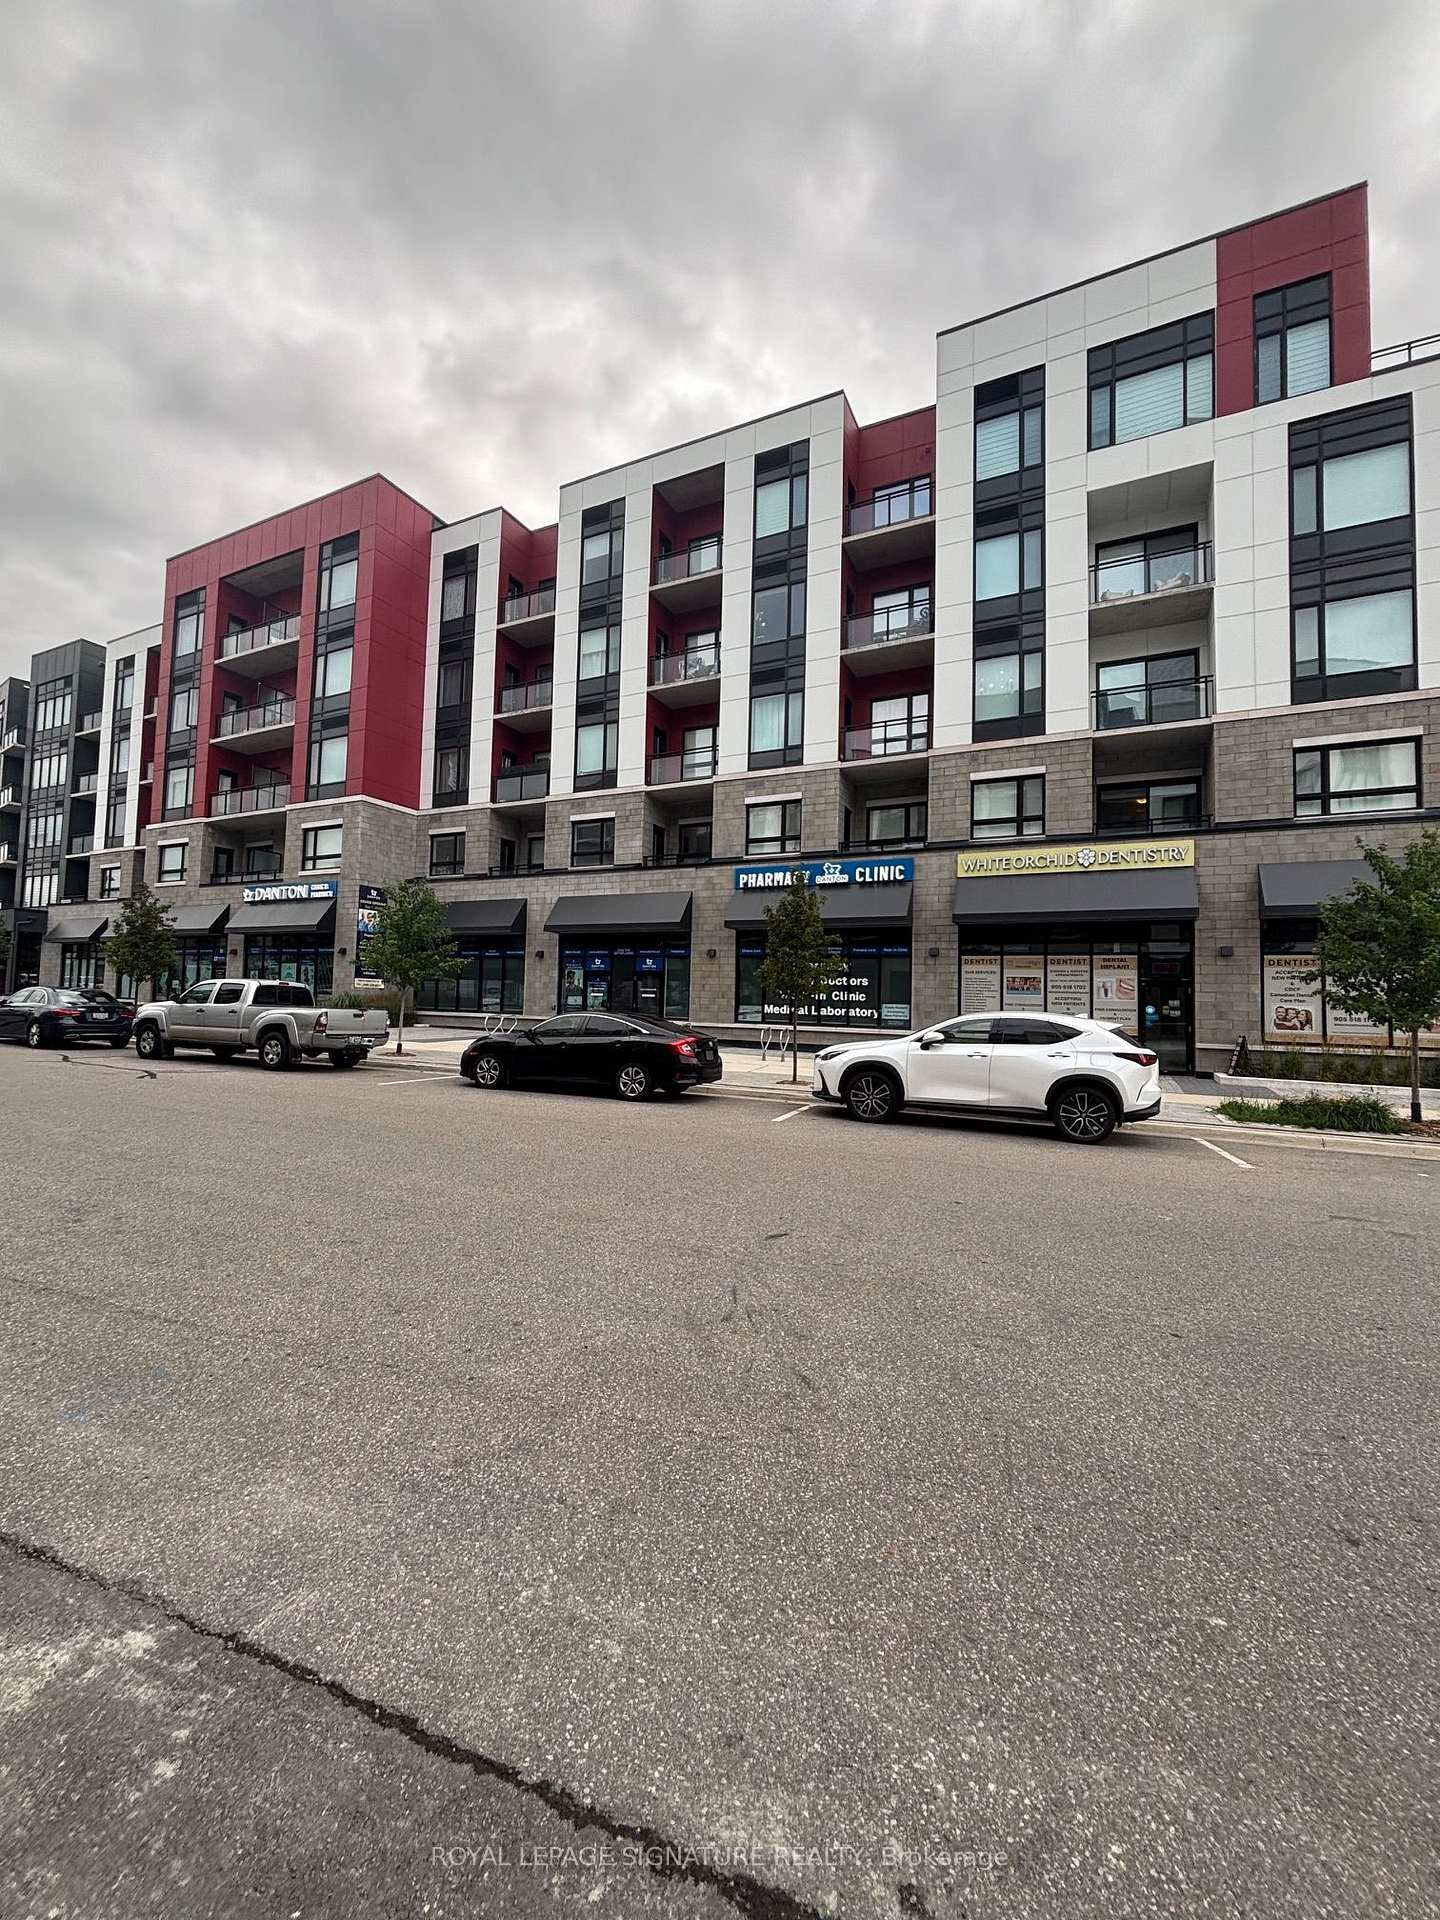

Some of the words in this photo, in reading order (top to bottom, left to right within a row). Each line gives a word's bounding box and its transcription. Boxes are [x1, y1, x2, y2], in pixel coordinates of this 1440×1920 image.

[961, 857, 1011, 872] WHITE
[1012, 853, 1076, 869] ORCHID
[1098, 847, 1190, 865] DENTISTRY
[816, 875, 849, 884] DANTON
[855, 865, 905, 882] CLINIC
[254, 884, 309, 901] DANTON
[1268, 959, 1317, 967] DENTIST
[831, 990, 867, 1002] Clinic
[811, 1005, 878, 1019] Laboratory
